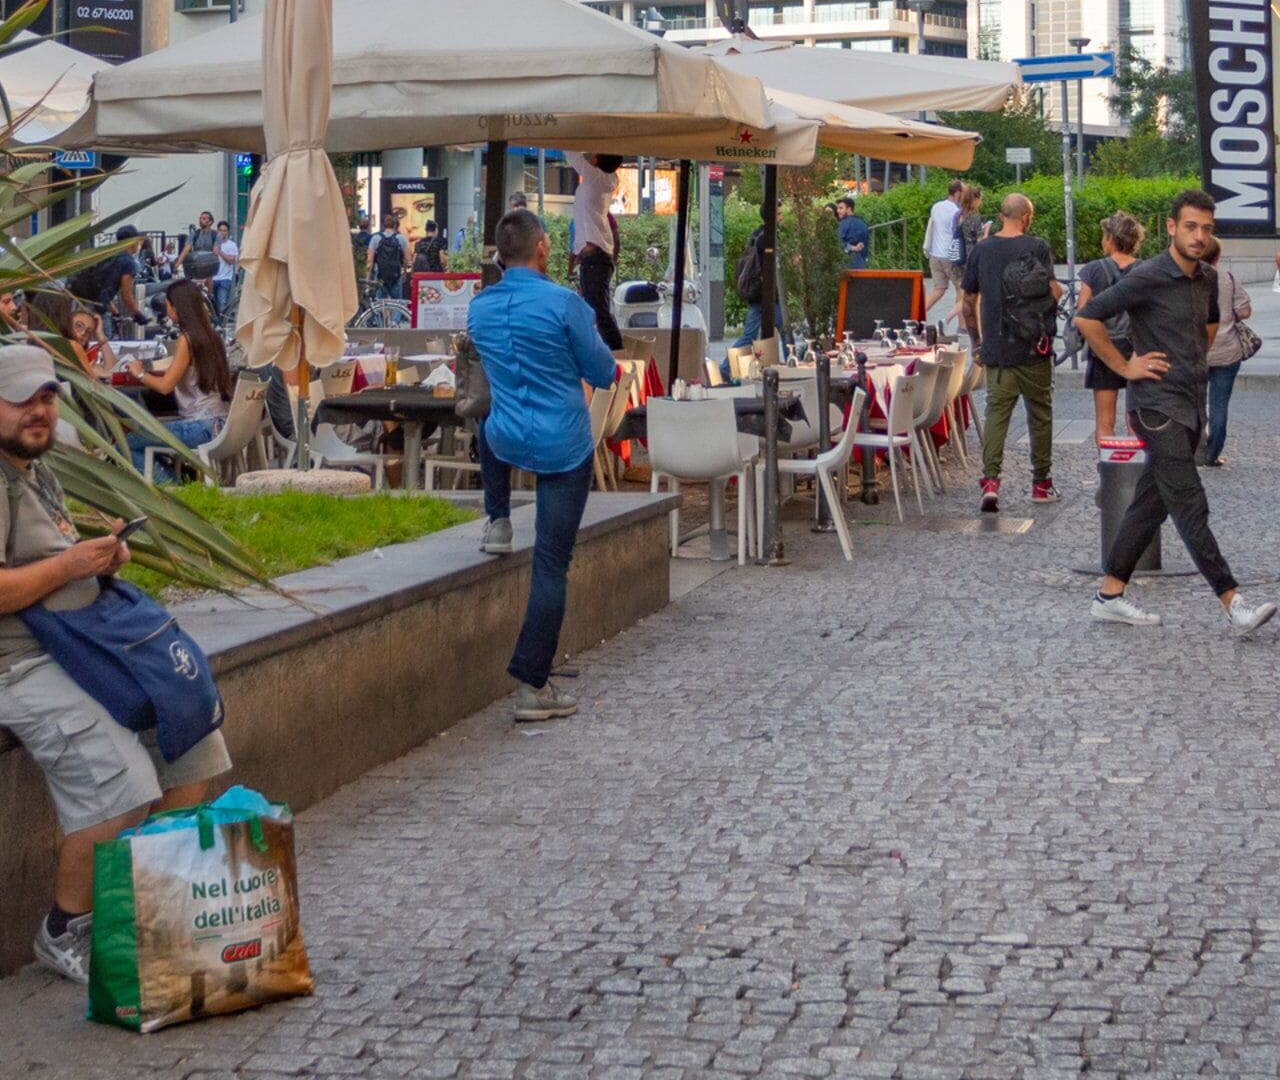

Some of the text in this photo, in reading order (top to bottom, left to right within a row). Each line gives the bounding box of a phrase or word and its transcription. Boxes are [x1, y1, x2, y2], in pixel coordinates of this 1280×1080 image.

[77, 7, 134, 20] 02 67160201
[715, 145, 777, 159] Heineken
[397, 183, 426, 191] CHANEL
[191, 877, 227, 899] Nel
